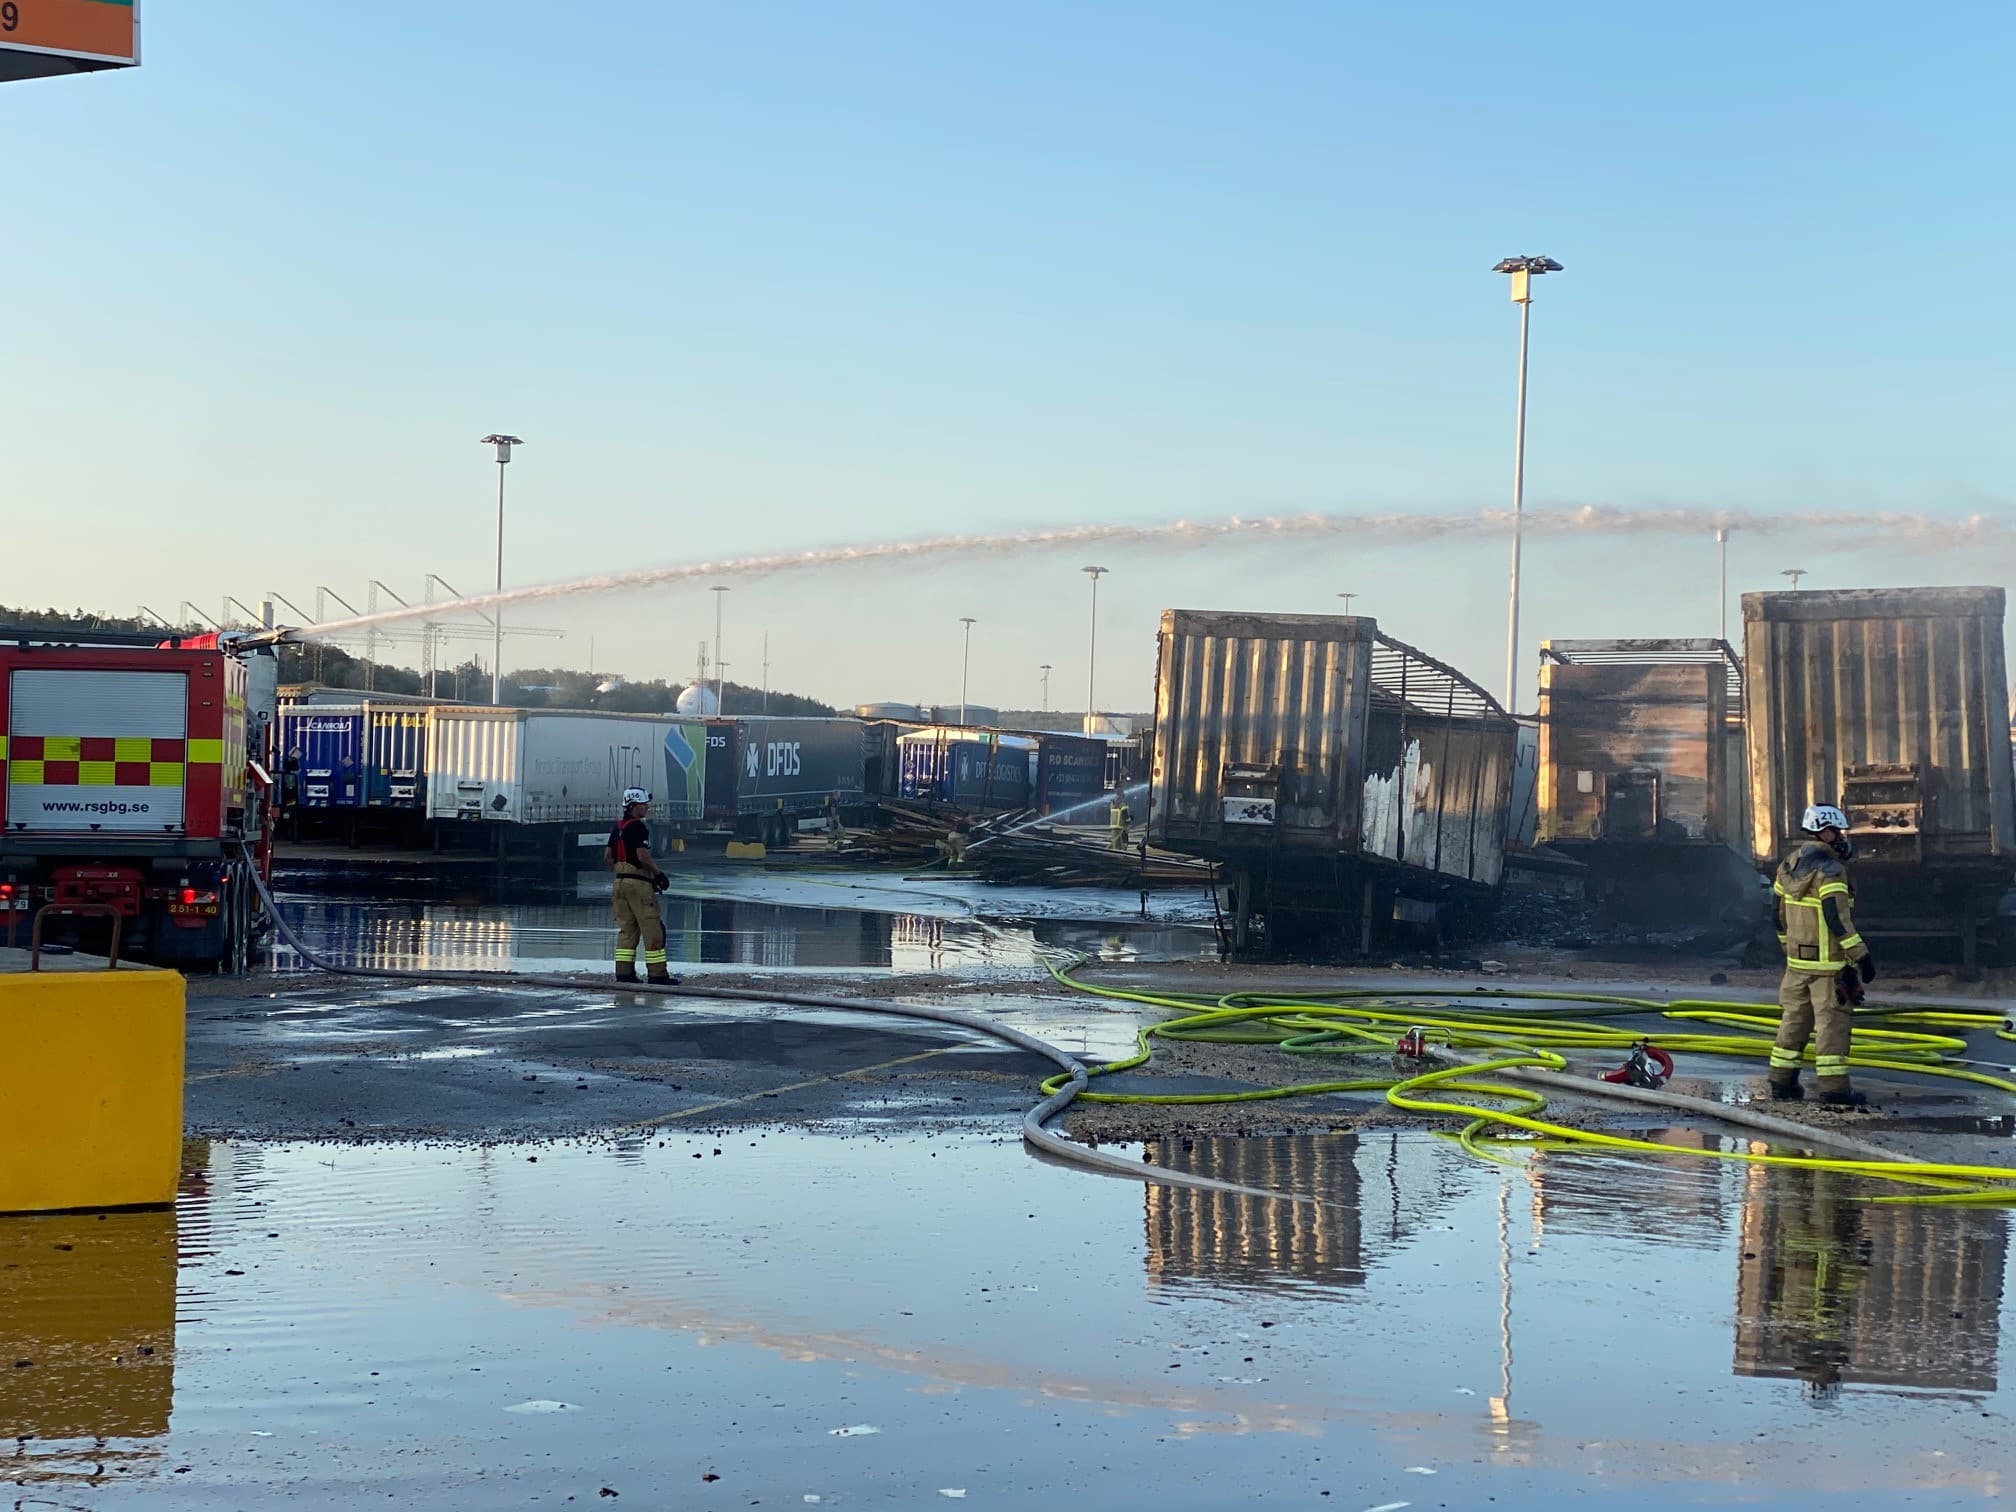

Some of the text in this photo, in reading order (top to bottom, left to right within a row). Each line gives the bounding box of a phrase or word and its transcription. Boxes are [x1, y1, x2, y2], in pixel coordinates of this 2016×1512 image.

[1, 1, 19, 31] 9
[400, 716, 430, 728] WALT
[705, 736, 726, 748] FDS
[608, 745, 642, 791] NTG
[767, 742, 801, 776] DFDS
[43, 800, 149, 815] www.rsgbg.se
